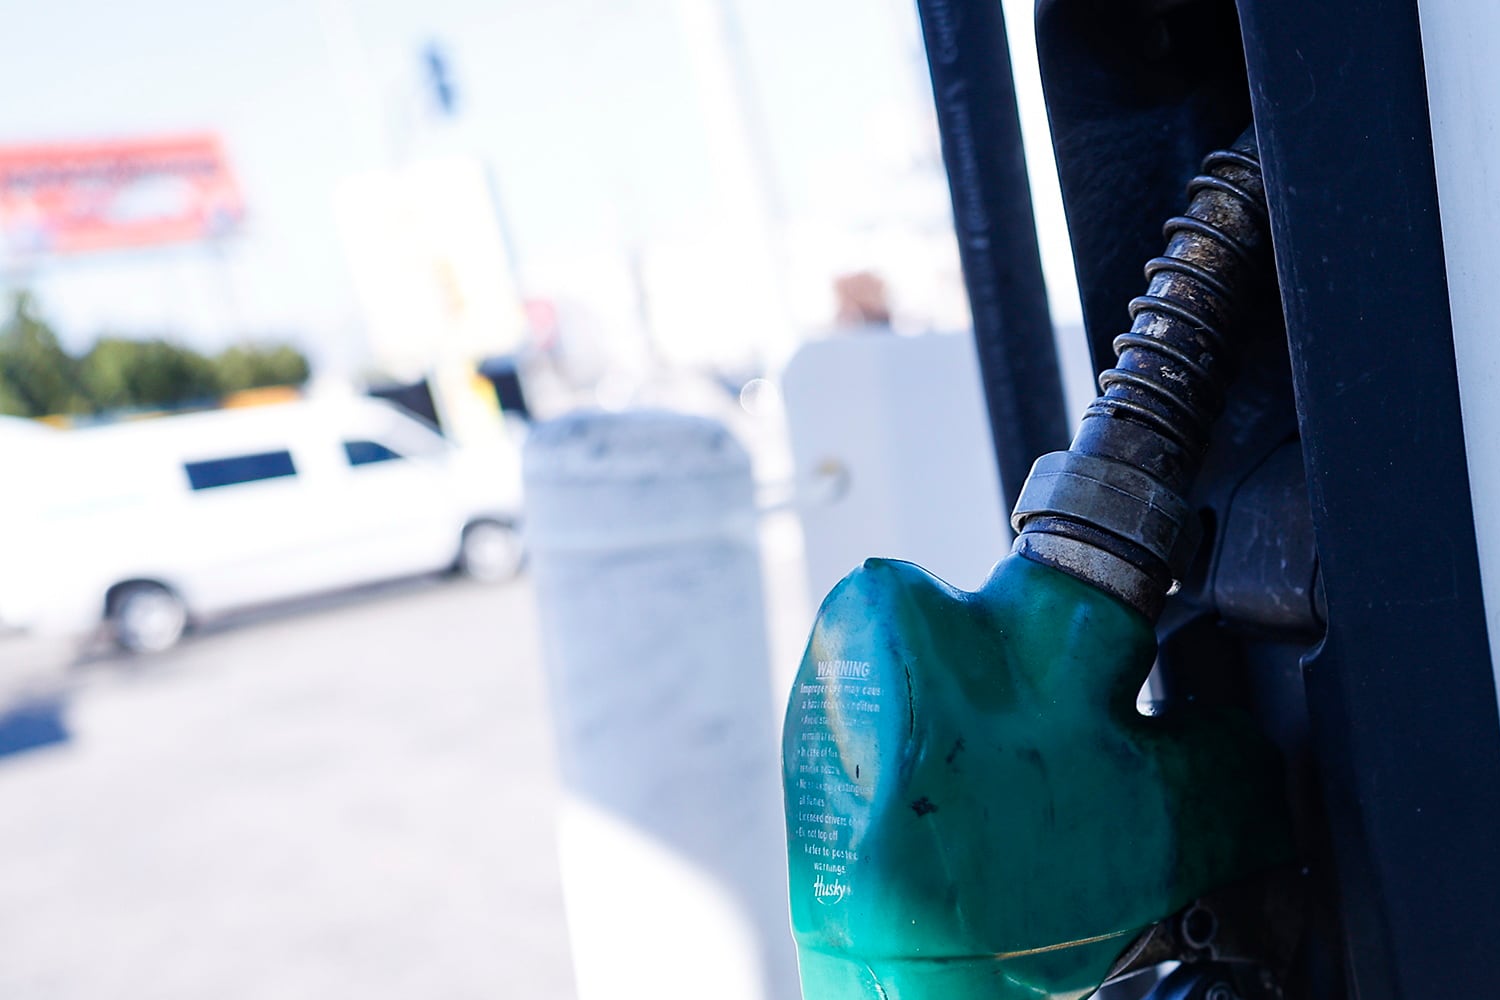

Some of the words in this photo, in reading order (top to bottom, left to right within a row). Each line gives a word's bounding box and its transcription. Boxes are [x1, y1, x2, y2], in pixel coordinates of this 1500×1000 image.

[817, 661, 870, 677] WARNING
[844, 685, 860, 697] may
[818, 829, 828, 842] top
[829, 830, 838, 841] off
[813, 862, 847, 876] warnings
[813, 874, 847, 905] Husky
